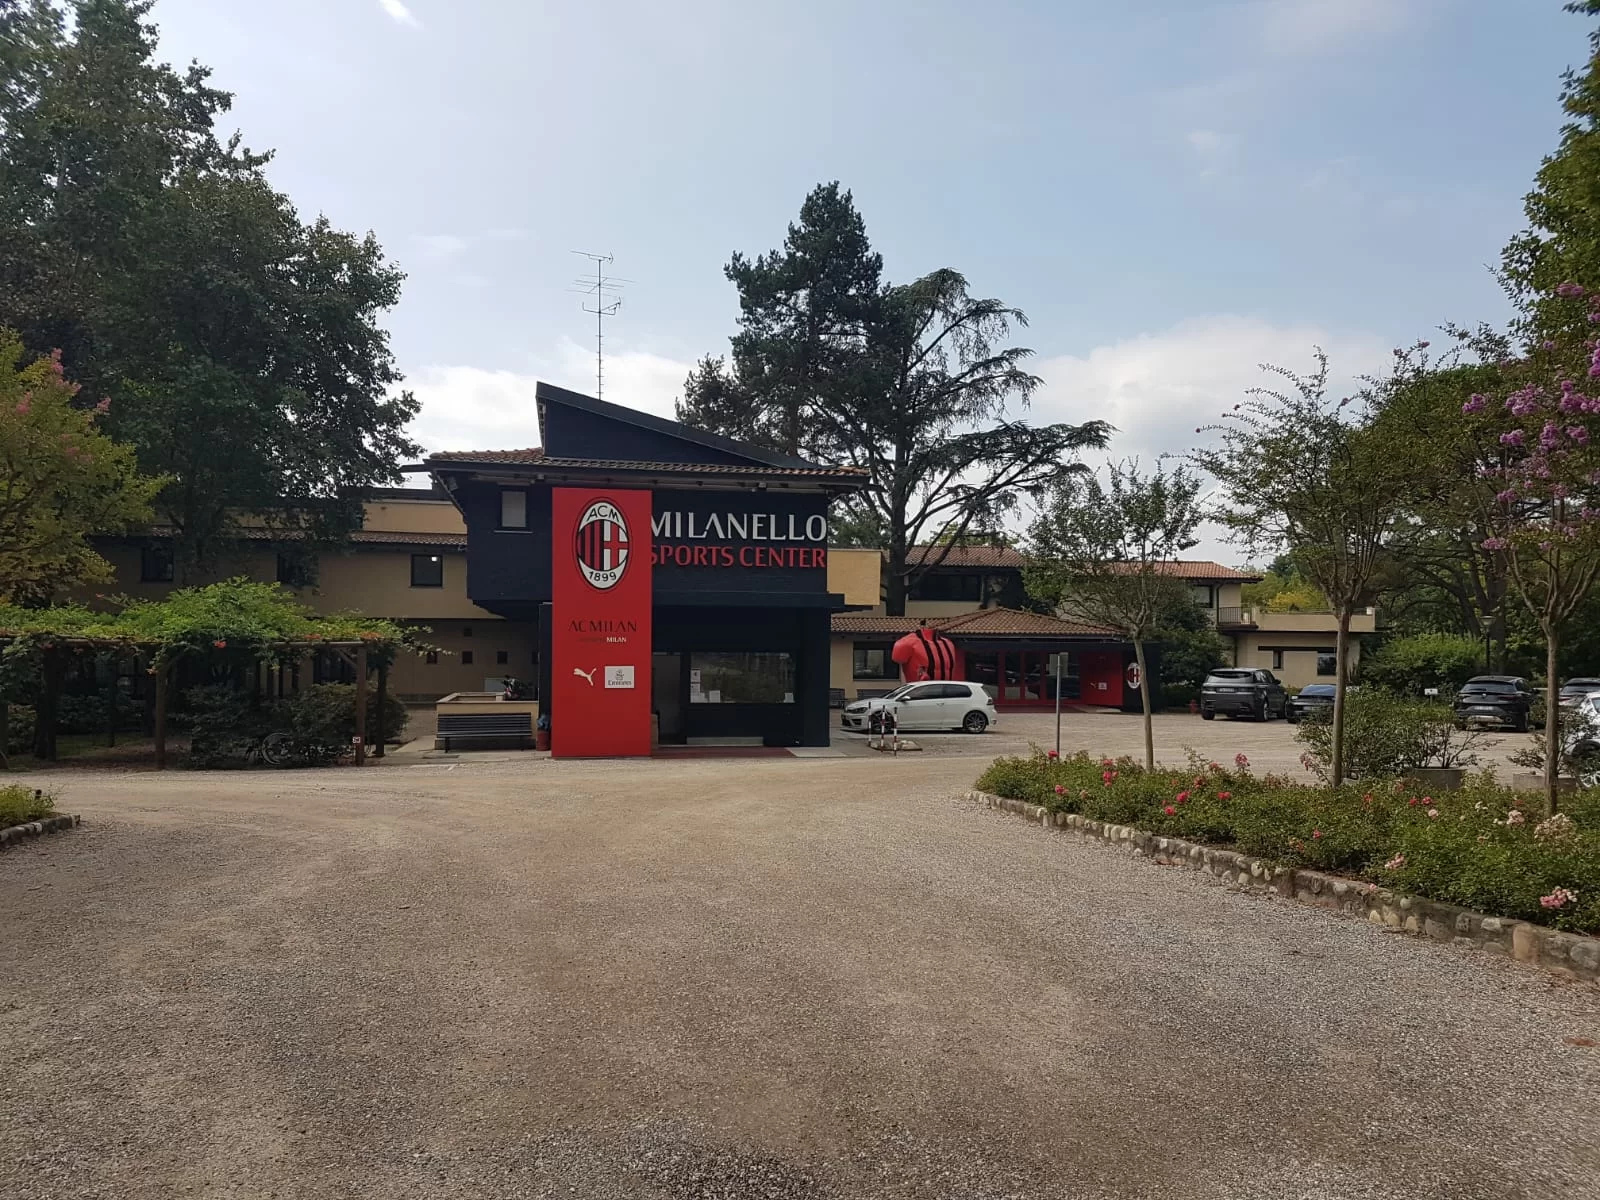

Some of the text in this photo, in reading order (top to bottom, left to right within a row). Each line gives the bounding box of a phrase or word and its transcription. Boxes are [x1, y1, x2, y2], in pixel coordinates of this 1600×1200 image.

[586, 505, 620, 522] ACM
[651, 511, 827, 541] MILANELLO
[739, 546, 826, 568] CENTER
[588, 571, 617, 582] 1899
[568, 620, 637, 632] AC MILAN
